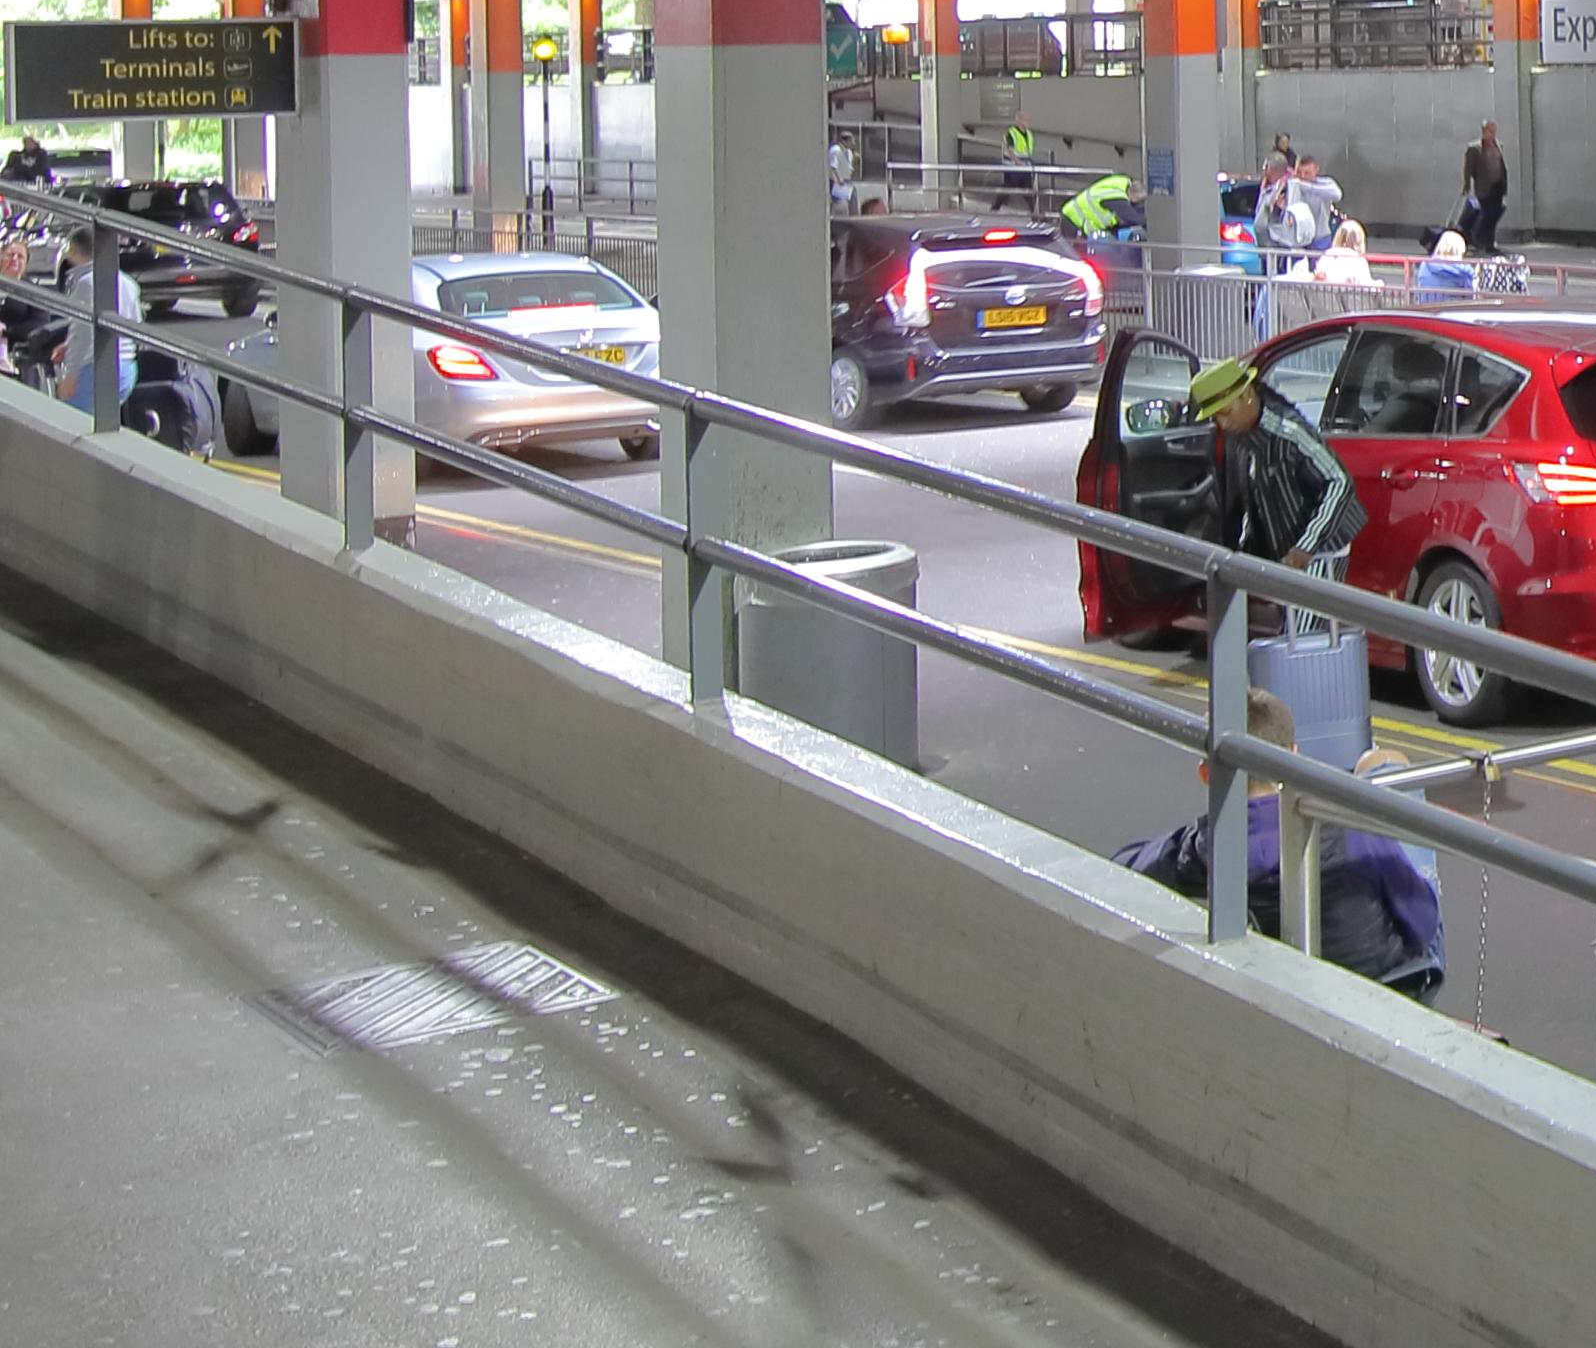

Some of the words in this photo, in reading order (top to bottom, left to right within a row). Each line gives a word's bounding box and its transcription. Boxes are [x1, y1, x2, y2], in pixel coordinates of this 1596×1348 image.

[129, 29, 177, 49] Lifts
[184, 29, 215, 49] to:
[100, 57, 215, 79] Terminals
[67, 88, 128, 110] Train
[135, 87, 216, 109] station
